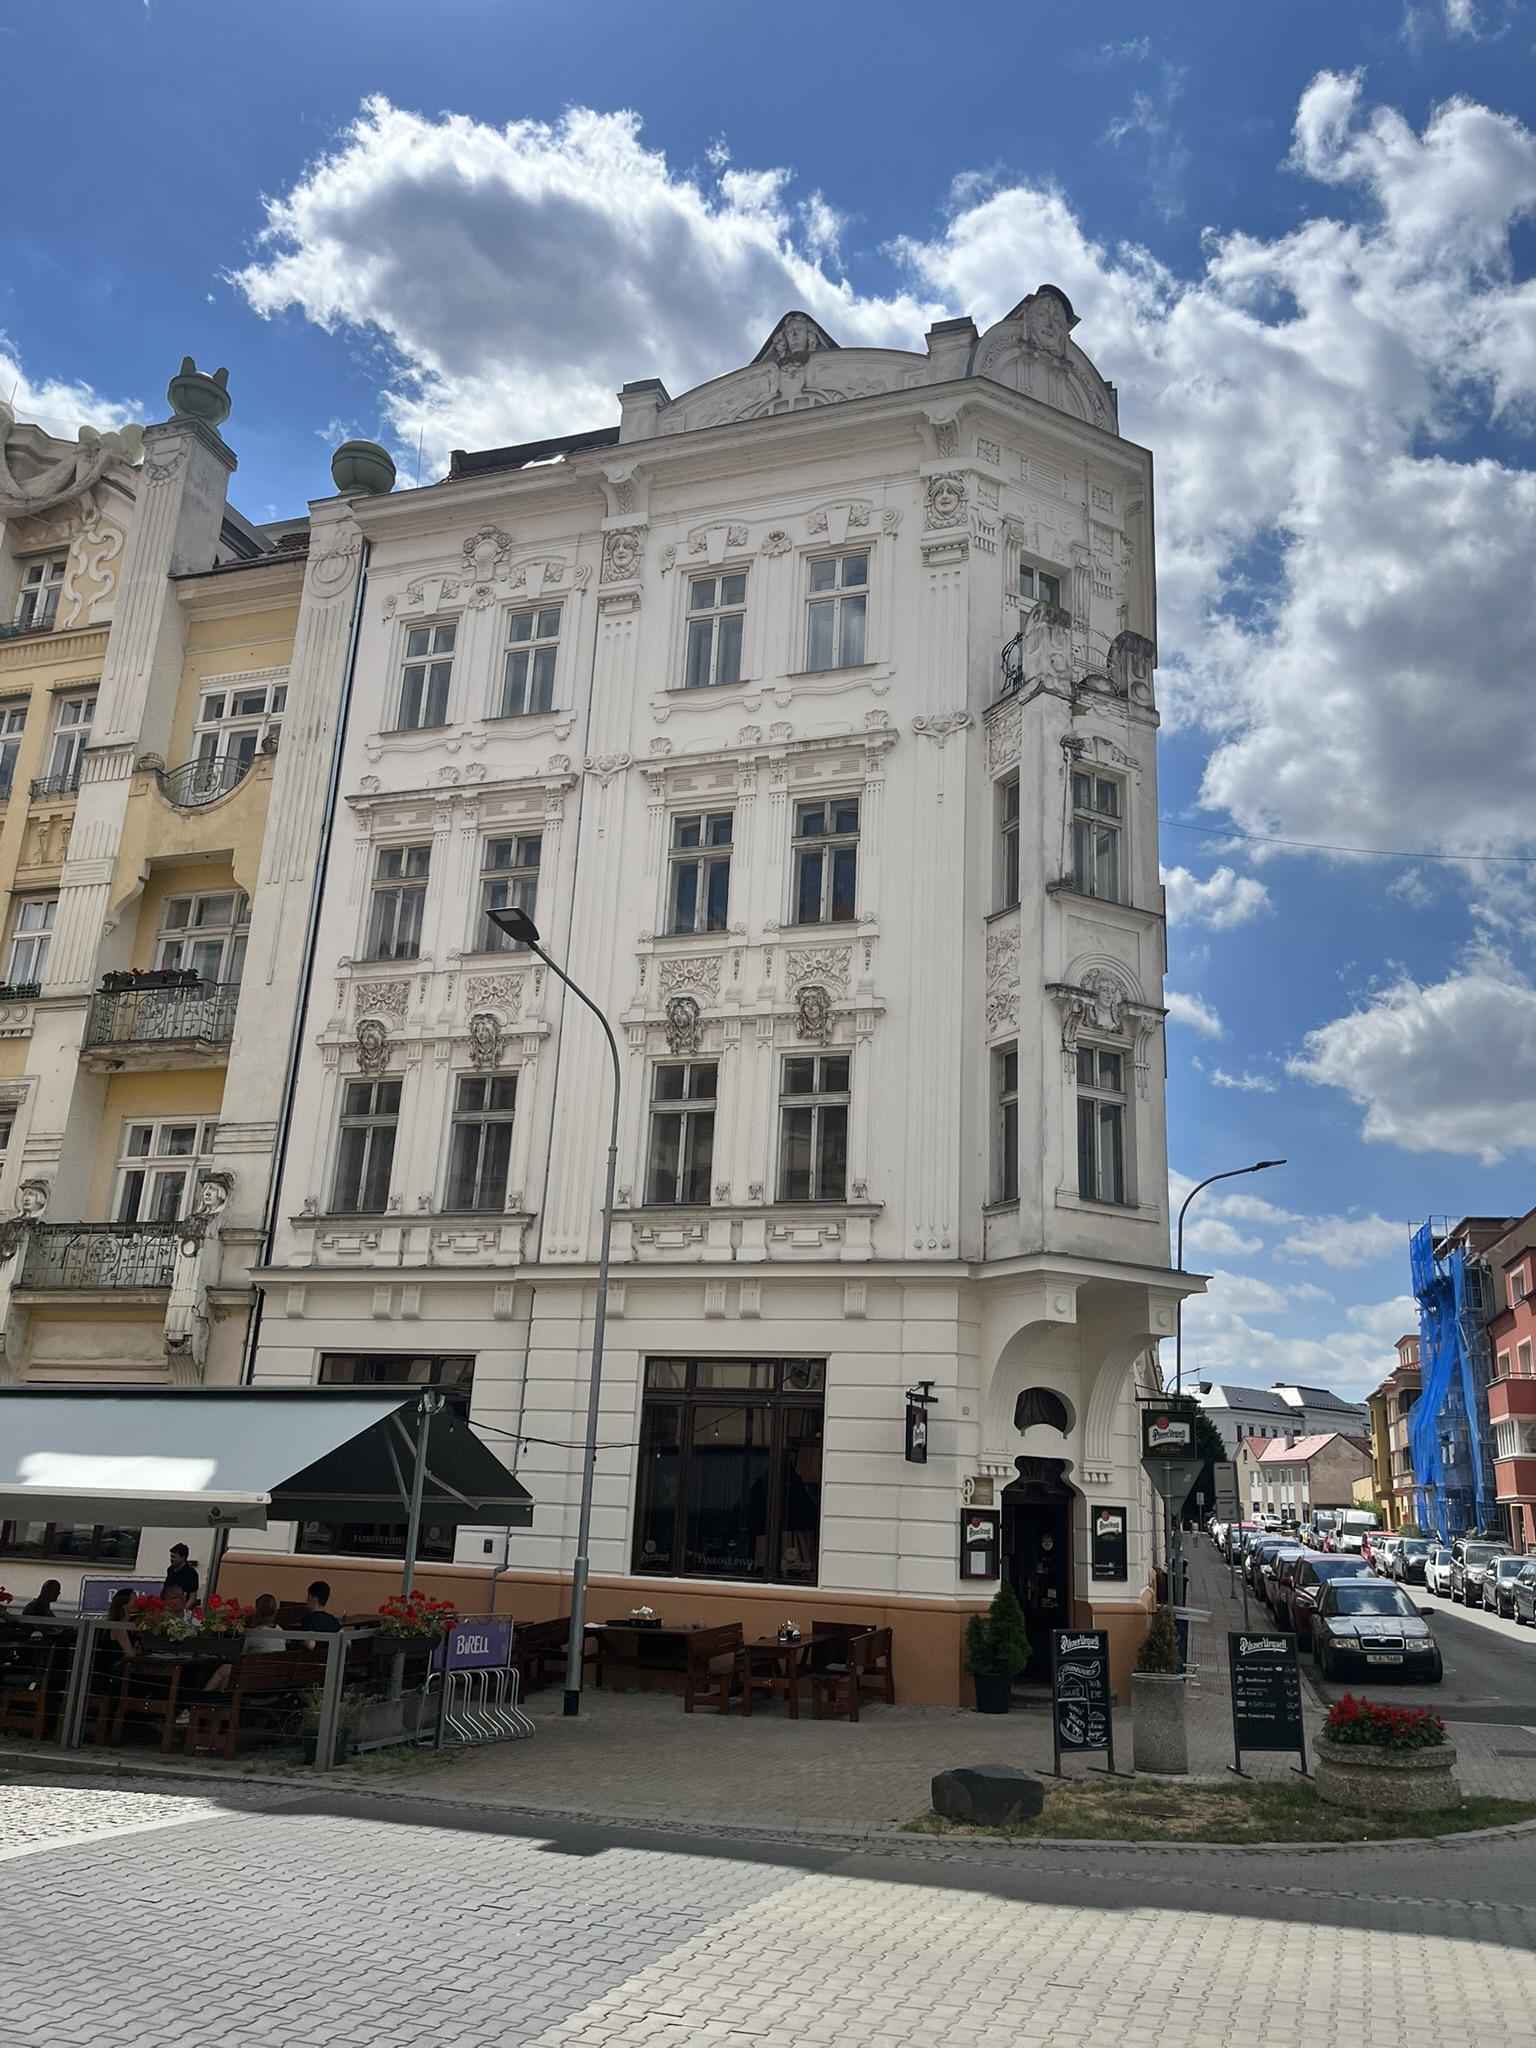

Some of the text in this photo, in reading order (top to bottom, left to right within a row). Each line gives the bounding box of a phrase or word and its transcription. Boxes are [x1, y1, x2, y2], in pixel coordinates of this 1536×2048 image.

[1060, 1634, 1100, 1654] Pilsner Urquell
[1240, 1636, 1287, 1656] Pilsner Urquell
